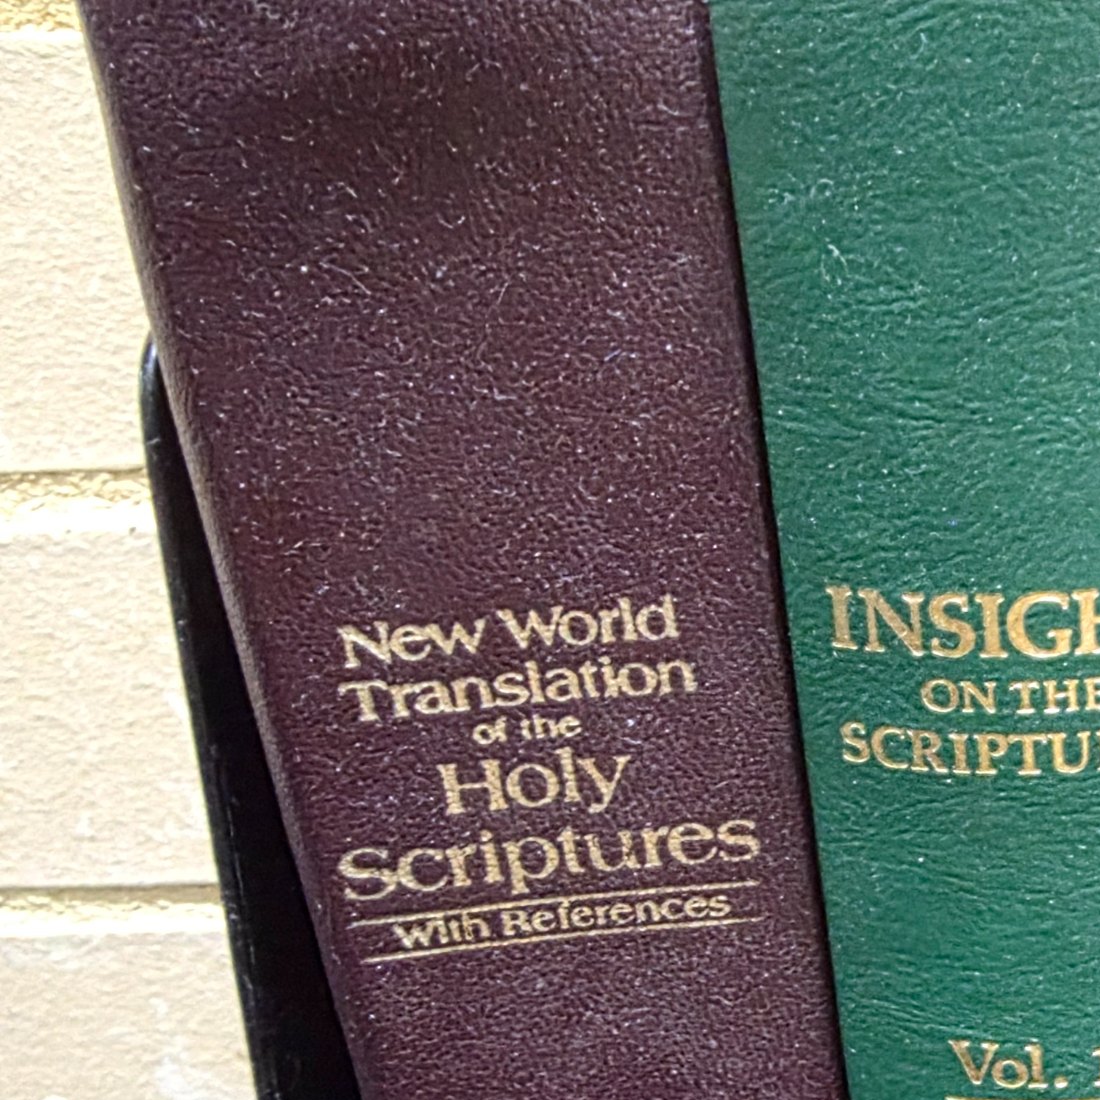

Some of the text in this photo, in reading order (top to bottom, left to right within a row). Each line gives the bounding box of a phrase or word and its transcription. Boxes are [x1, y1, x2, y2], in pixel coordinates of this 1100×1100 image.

[337, 594, 680, 668] New World
[338, 656, 698, 722] Translation
[921, 678, 1002, 713] ON
[472, 712, 582, 745] of the
[437, 746, 631, 814] Holy
[338, 819, 760, 900] Scriptures
[393, 894, 732, 949] With References
[948, 1039, 1067, 1090] Vol.
